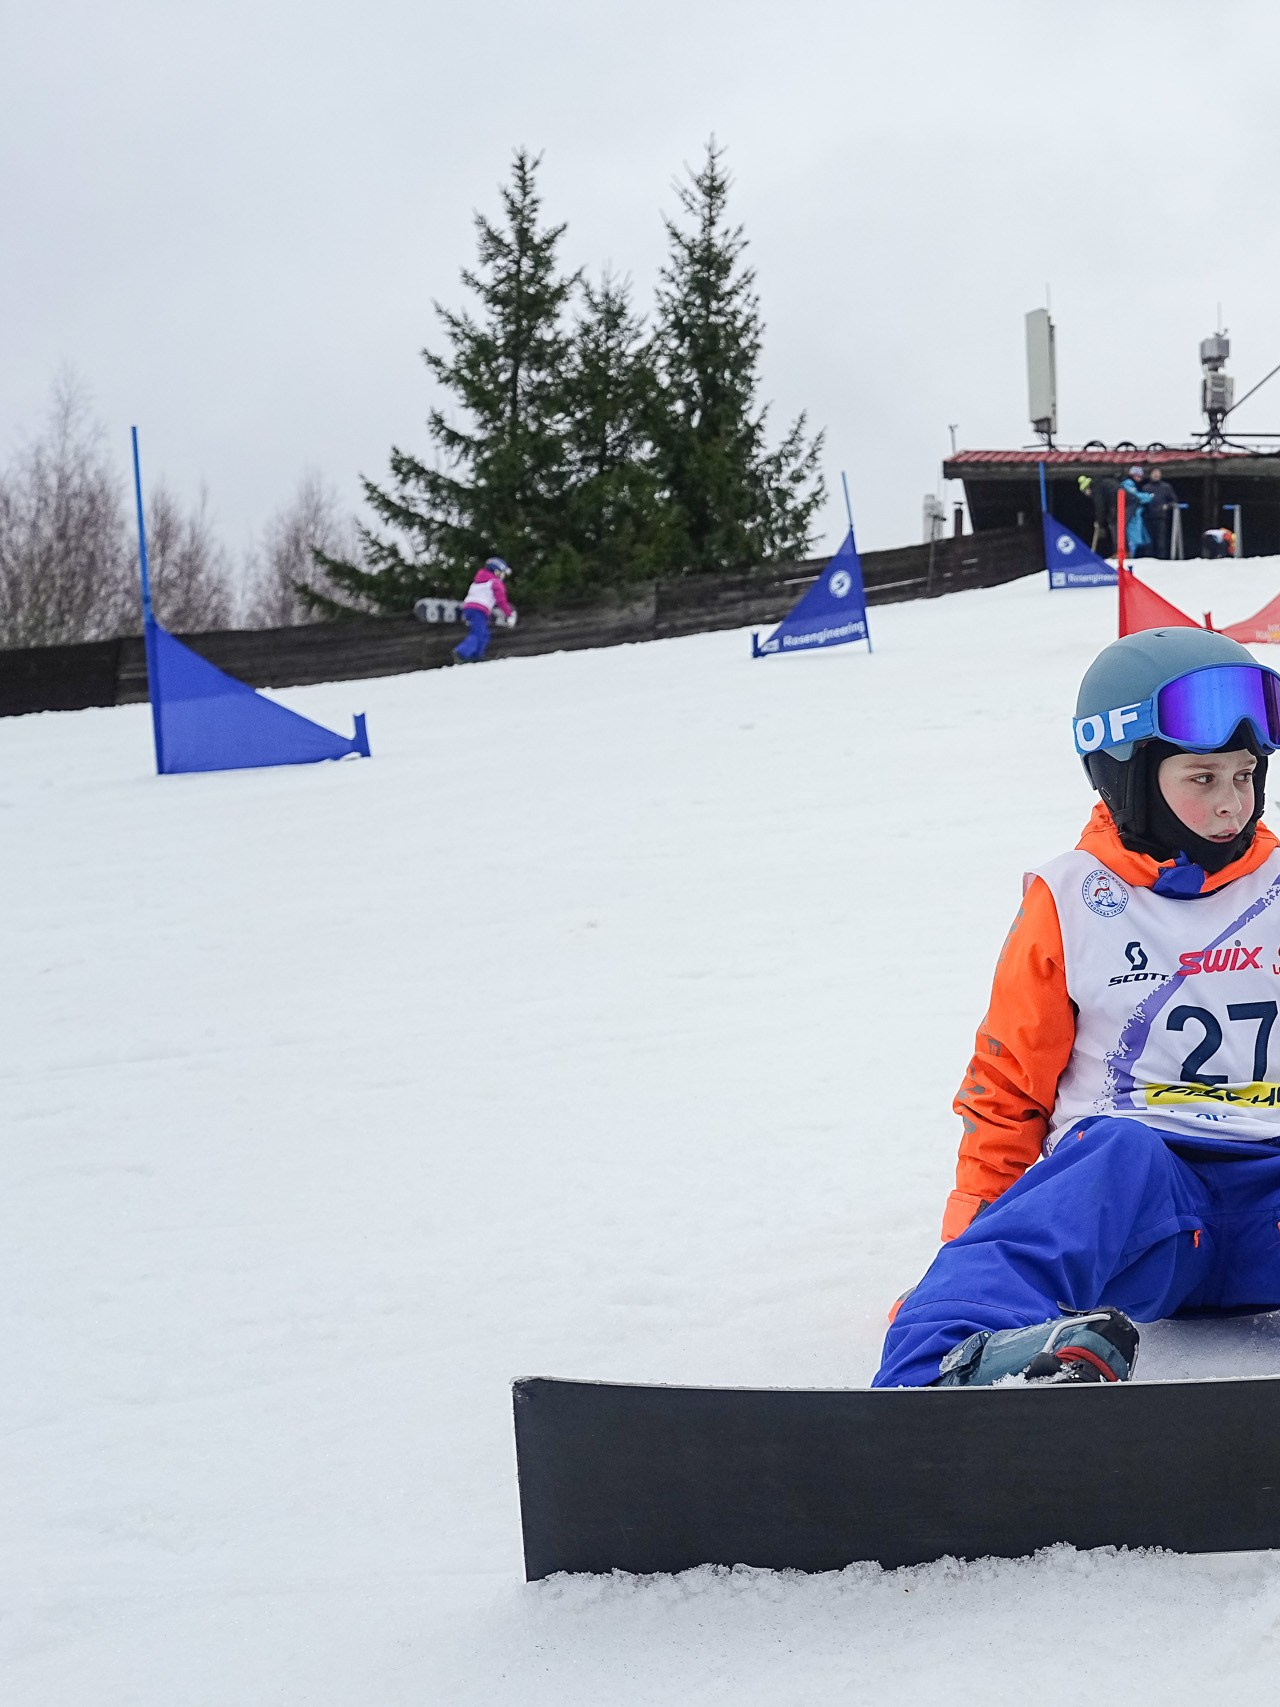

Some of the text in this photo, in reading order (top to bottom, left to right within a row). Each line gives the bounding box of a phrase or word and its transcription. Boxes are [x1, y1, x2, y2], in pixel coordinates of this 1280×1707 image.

[783, 620, 866, 646] Rosengineering
[1108, 972, 1169, 987] SCOTT
[1165, 1000, 1279, 1087] 27
